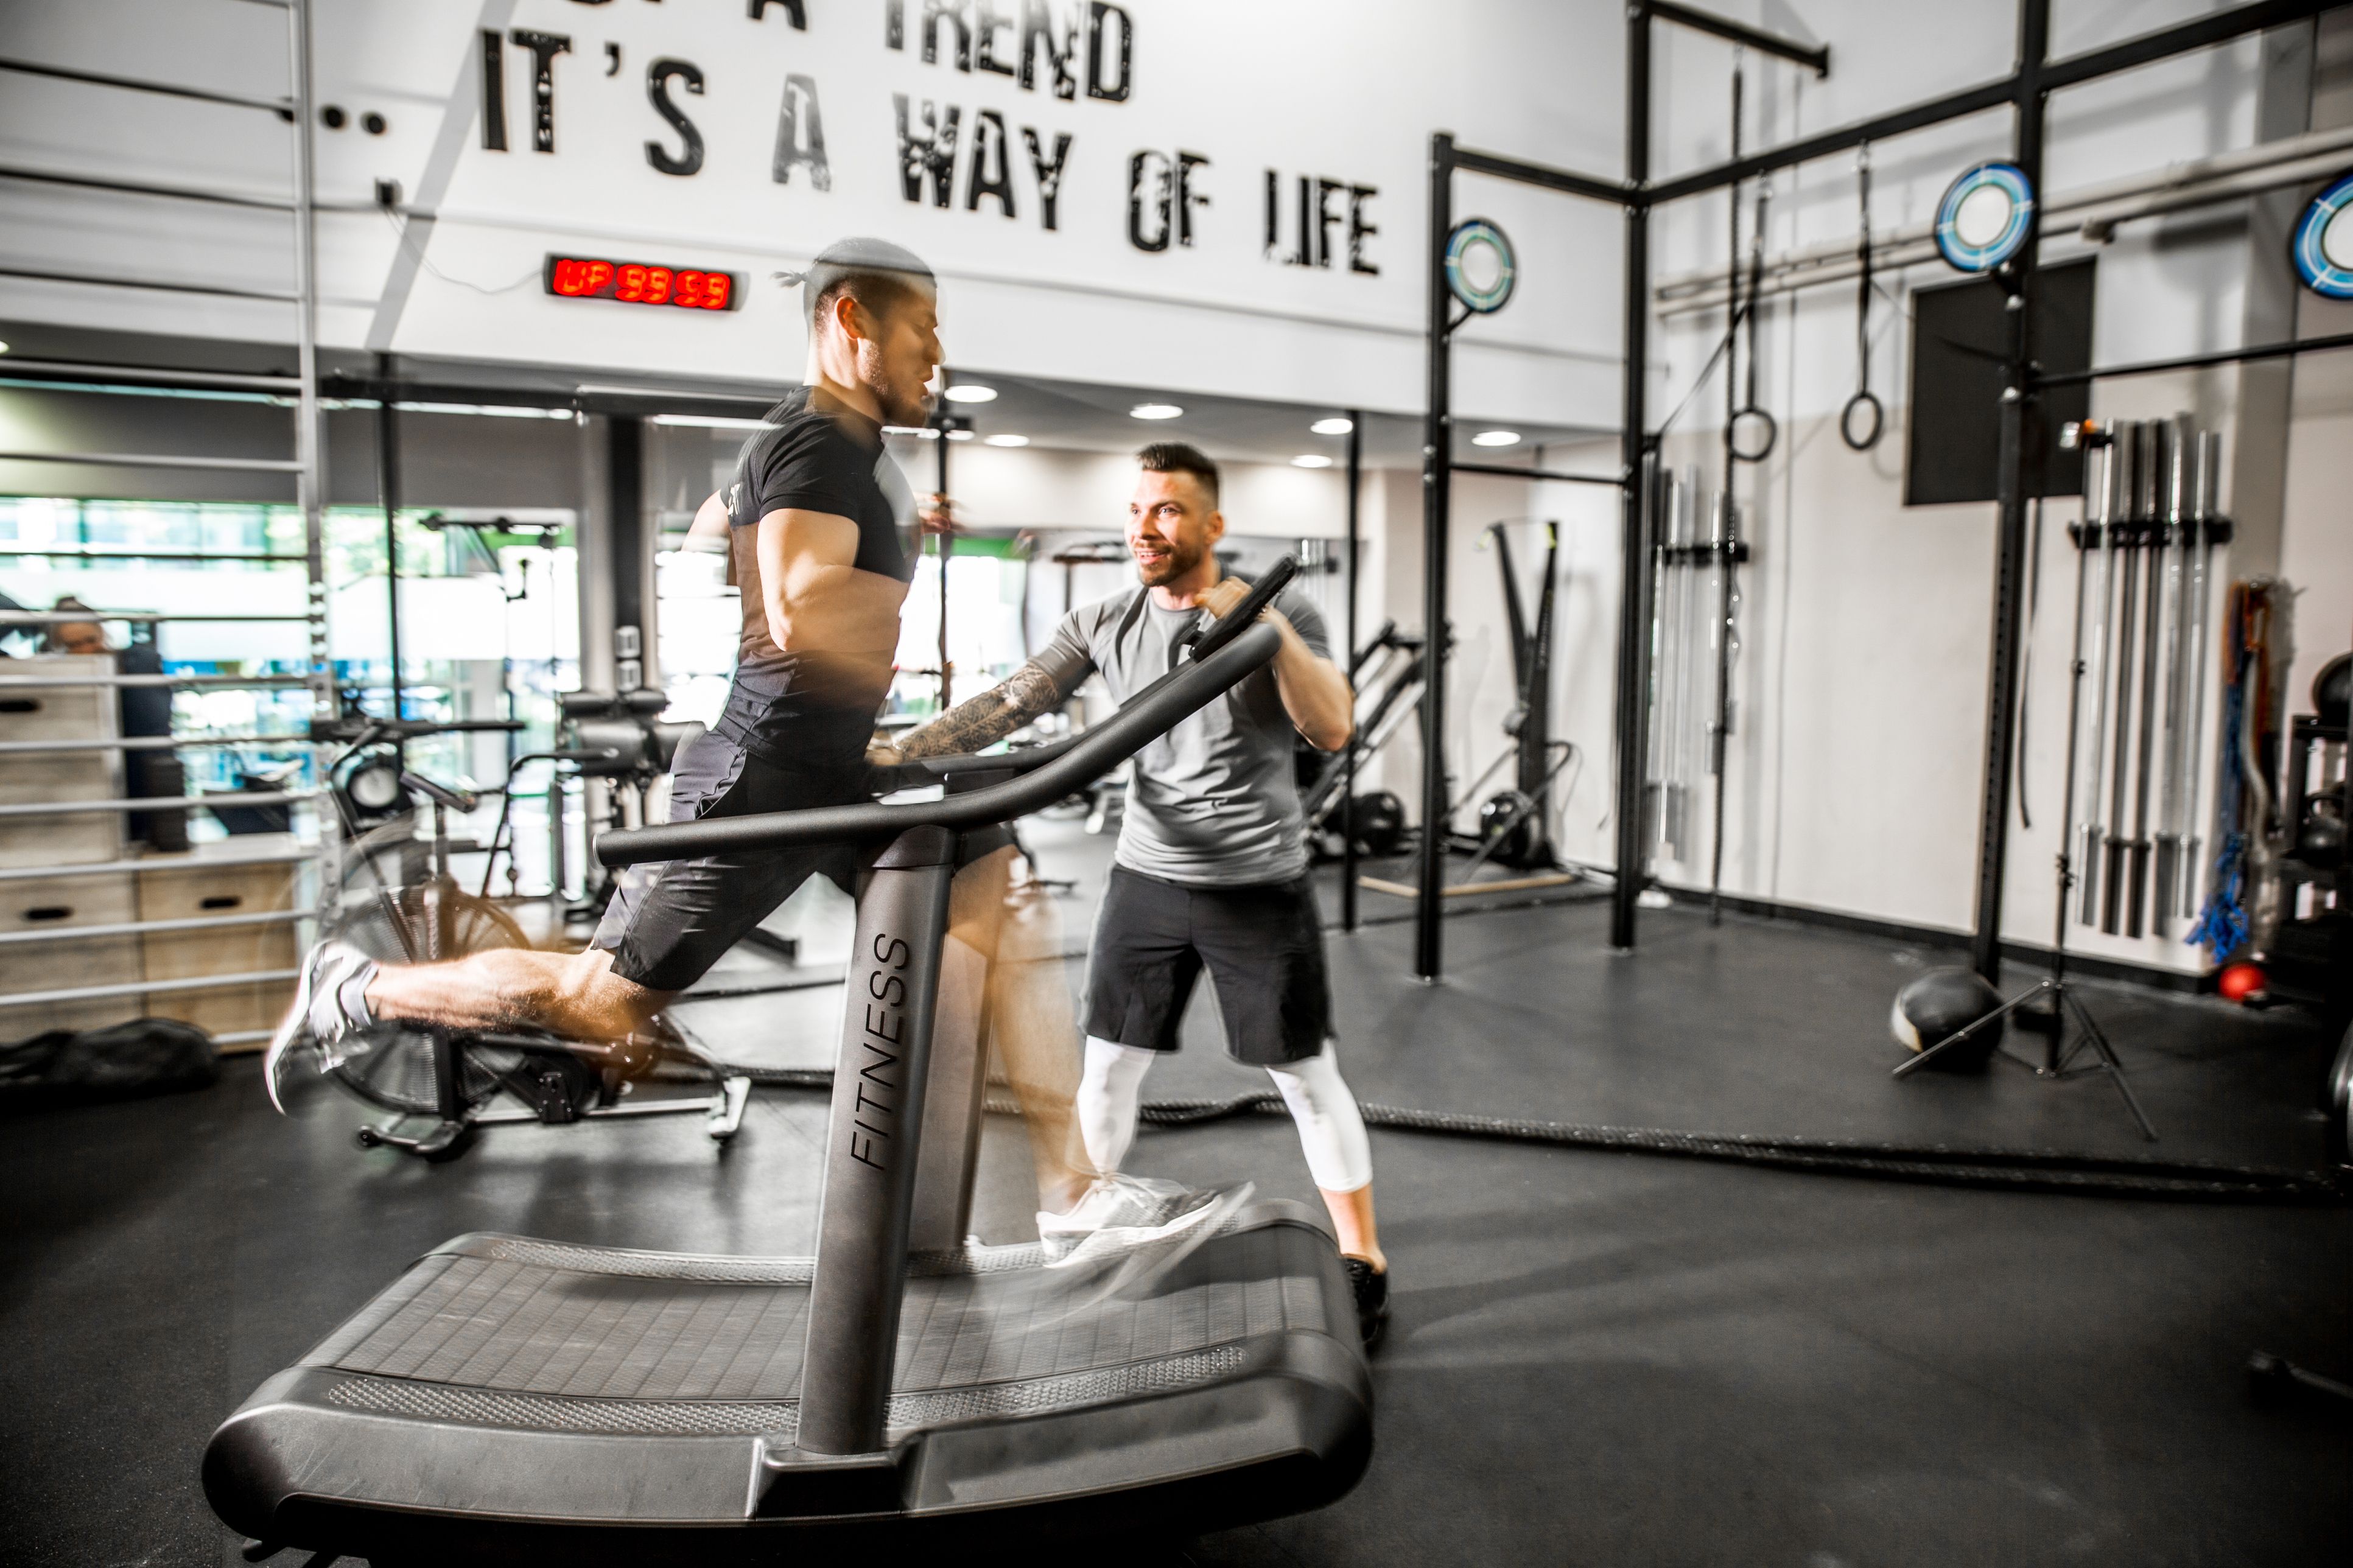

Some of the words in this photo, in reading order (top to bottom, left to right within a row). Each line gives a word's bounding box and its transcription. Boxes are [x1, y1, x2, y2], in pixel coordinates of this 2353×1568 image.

[478, 28, 705, 177] IT'S
[772, 72, 831, 191] A
[892, 91, 1073, 231] WAY
[1125, 150, 1211, 253] OF
[1264, 167, 1380, 275] LIFE
[850, 933, 910, 1171] FITNESS
